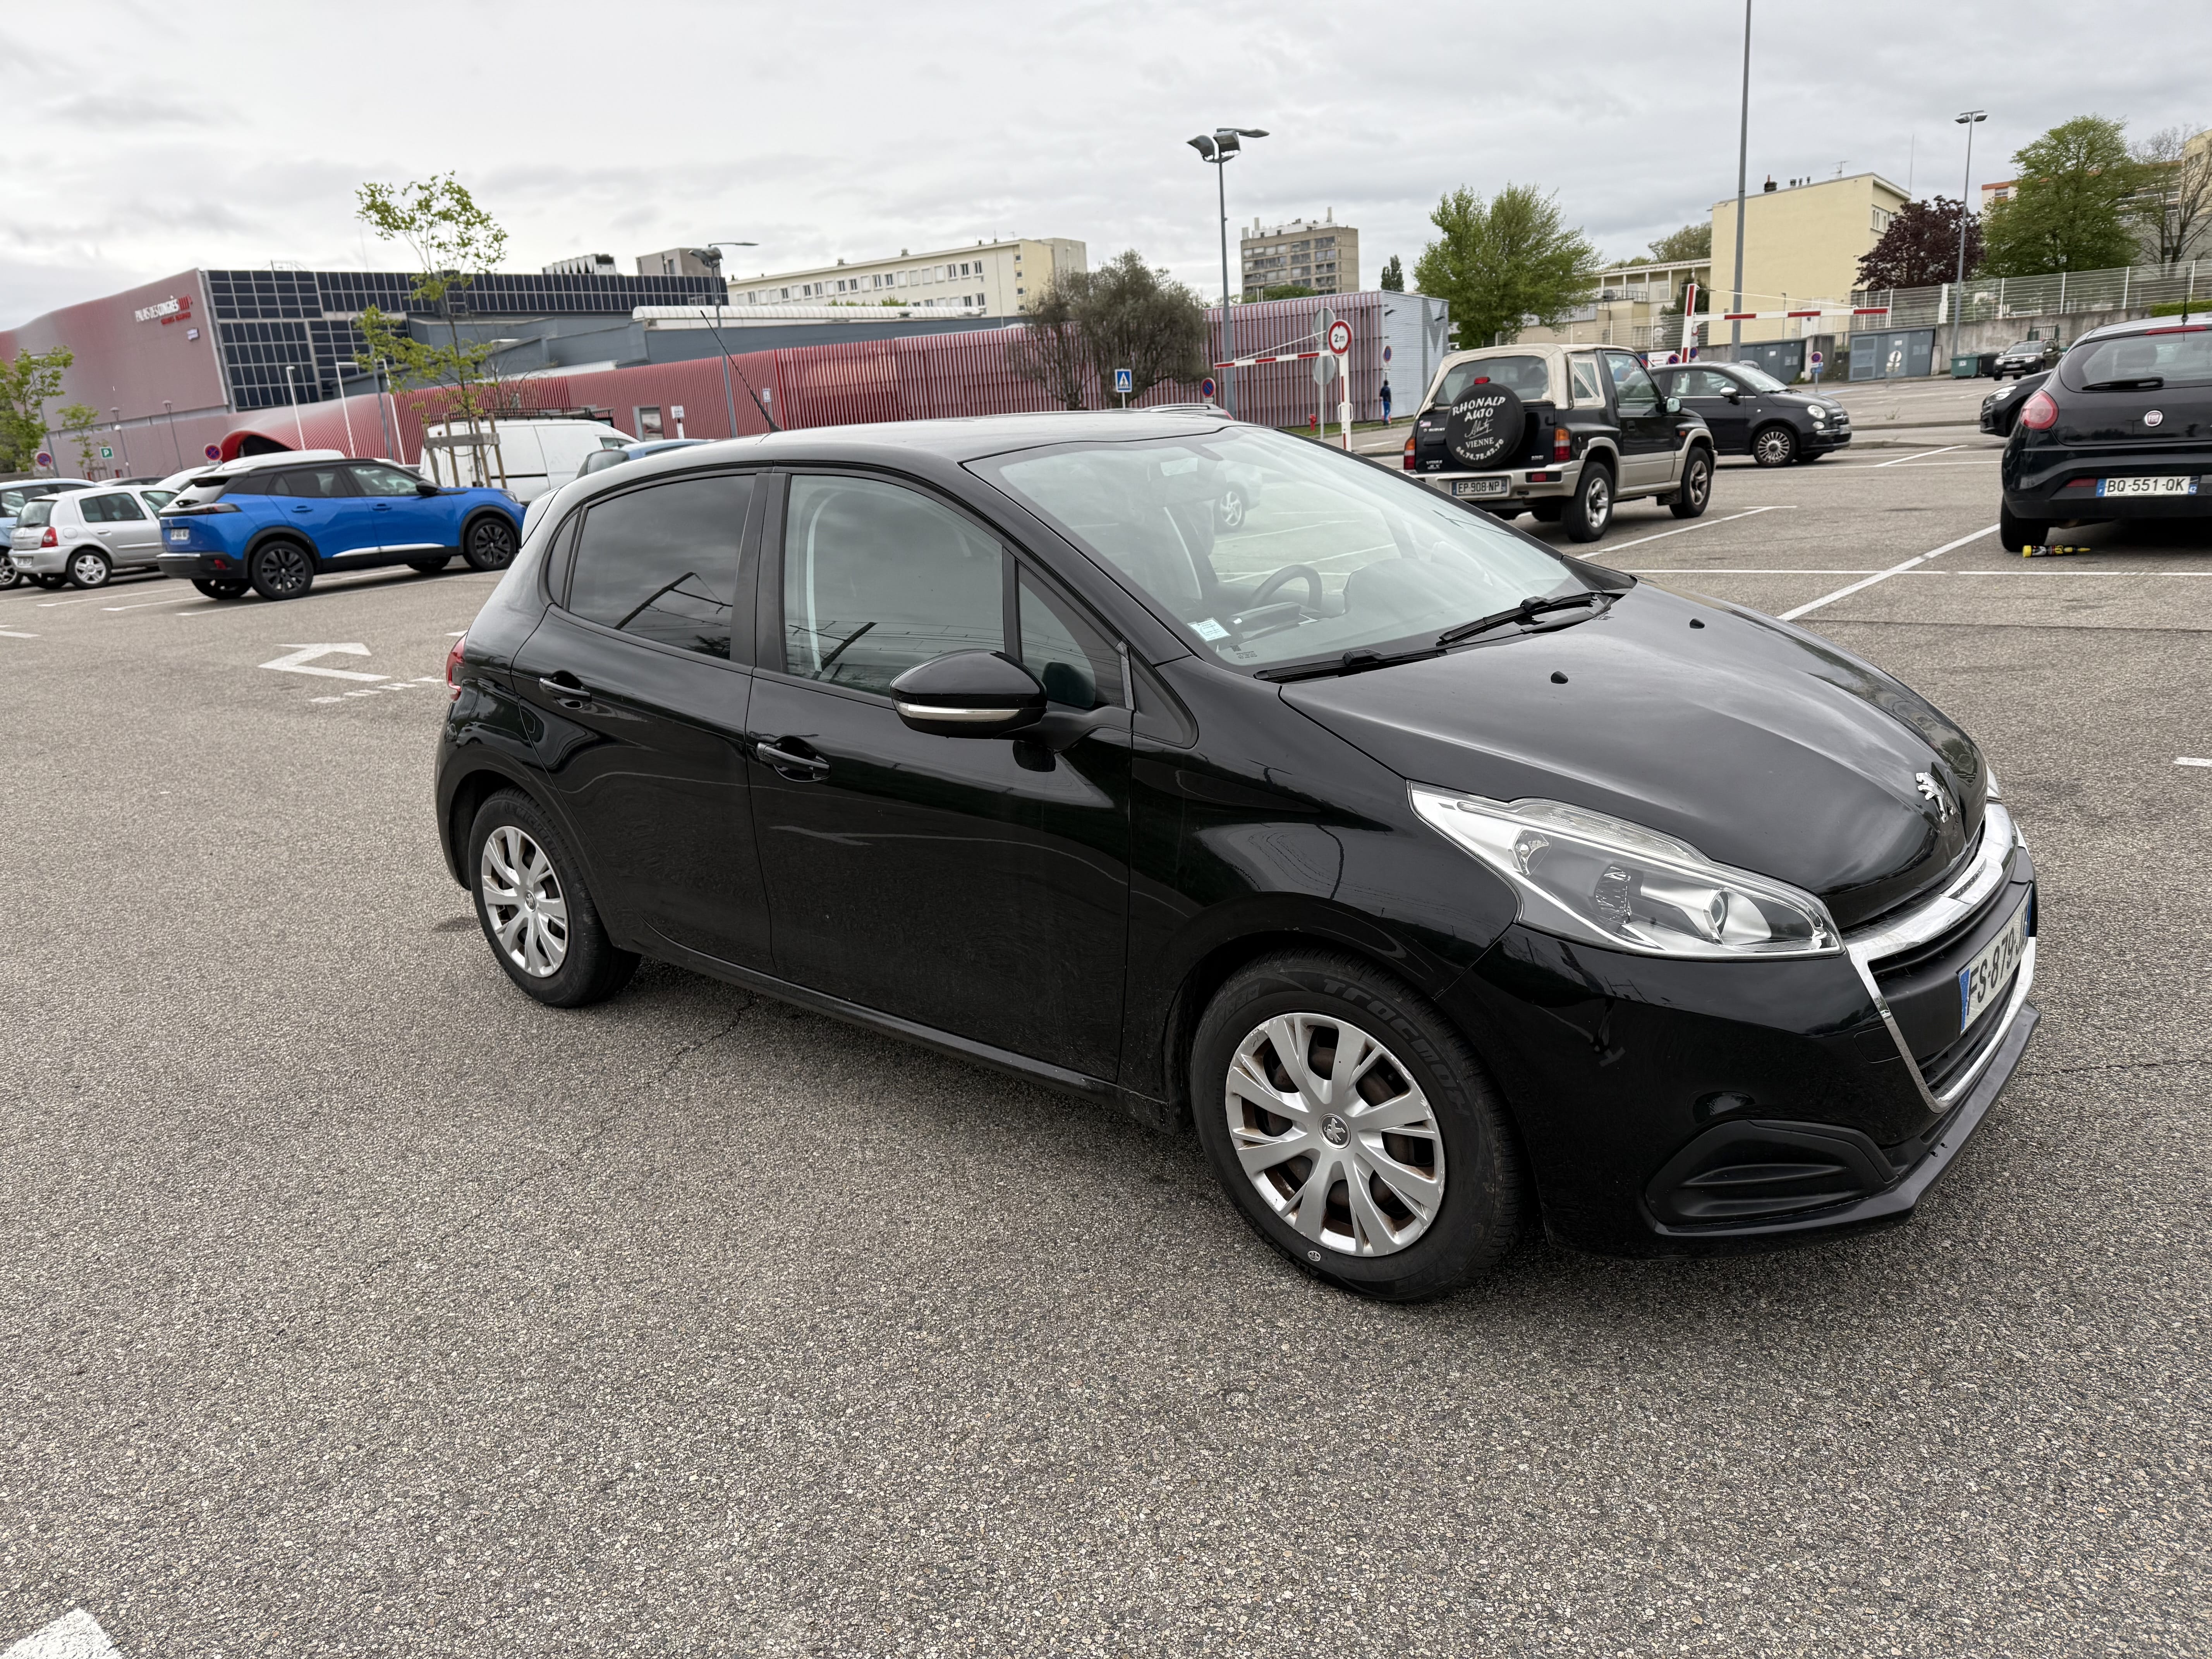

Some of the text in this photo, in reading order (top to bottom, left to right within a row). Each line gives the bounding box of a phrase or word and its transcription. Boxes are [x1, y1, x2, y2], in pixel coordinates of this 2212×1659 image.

[1452, 396, 1506, 416] RHONALP
[1464, 407, 1494, 422] AUTO
[1465, 437, 1494, 448] VIENNE
[1458, 481, 1499, 493] EP-908-NP
[2107, 478, 2186, 493] BQ-551-QK
